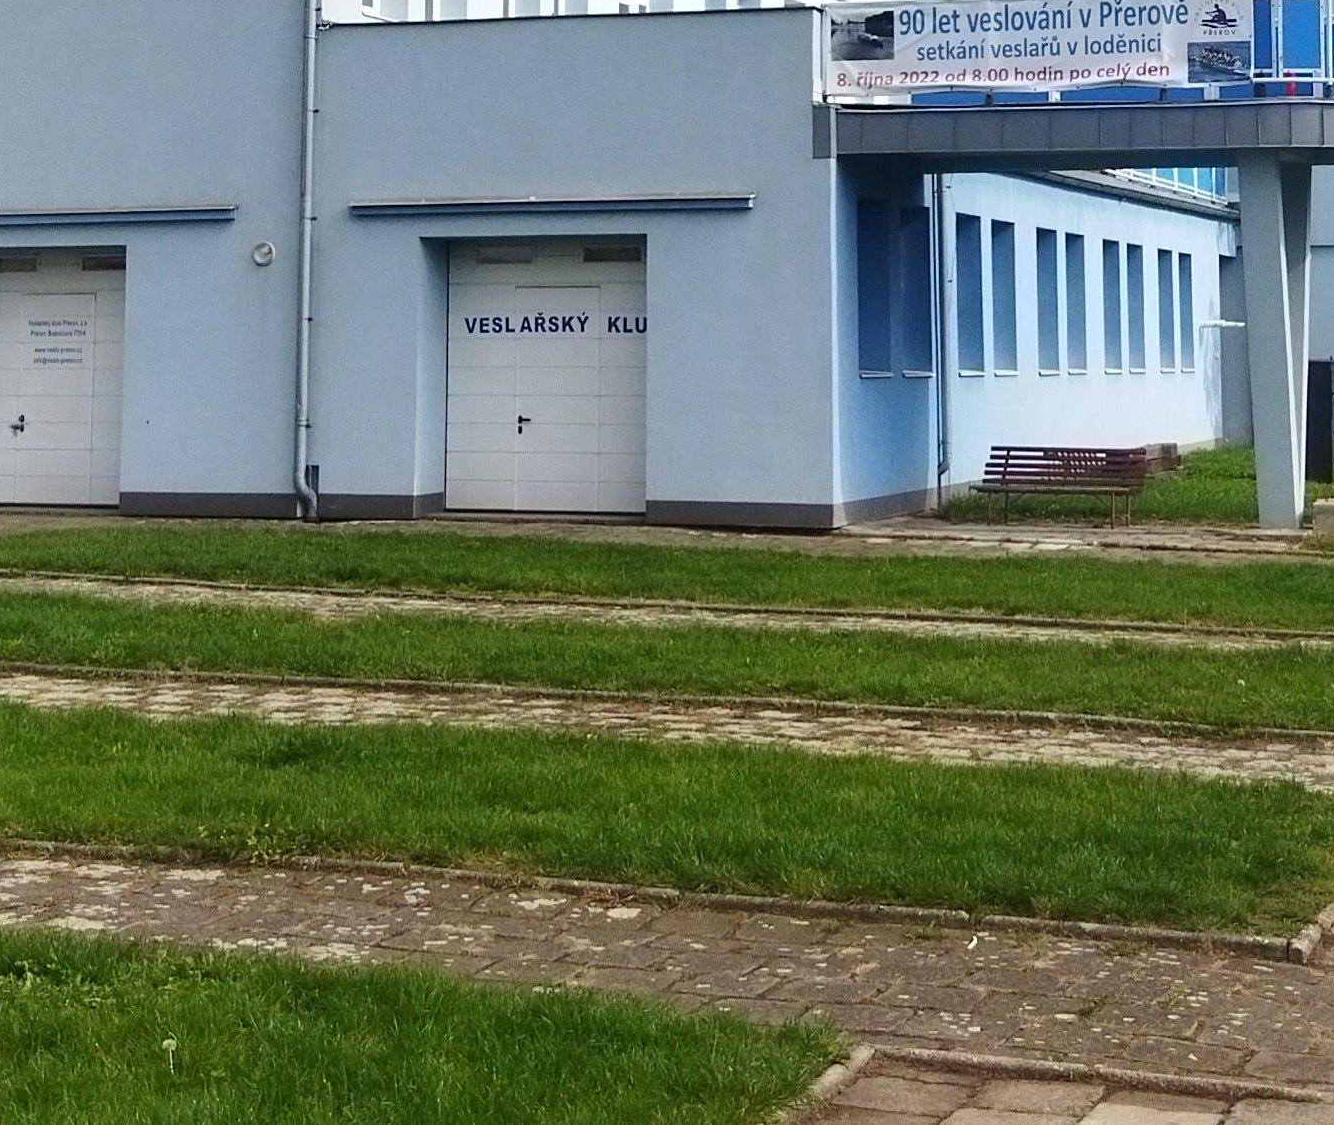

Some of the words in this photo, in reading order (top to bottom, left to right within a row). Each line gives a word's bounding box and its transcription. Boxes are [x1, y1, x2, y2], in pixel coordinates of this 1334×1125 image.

[899, 8, 925, 35] 90
[932, 6, 961, 34] let
[967, 0, 1072, 33] veslování
[1078, 8, 1092, 28] v
[917, 38, 985, 61] setkání
[990, 35, 1061, 58] veslařů
[1067, 40, 1078, 56] v
[1084, 32, 1161, 55] loděnici
[837, 73, 852, 87] 8.
[856, 71, 894, 90] října
[899, 70, 939, 84] 2022
[945, 68, 967, 82] od
[971, 68, 1009, 82] 8.00
[1014, 65, 1064, 81] hodin
[1069, 68, 1092, 82] po
[1096, 62, 1132, 81] celý
[1135, 62, 1170, 77] den
[464, 311, 589, 334] VESLAŘSKÝ
